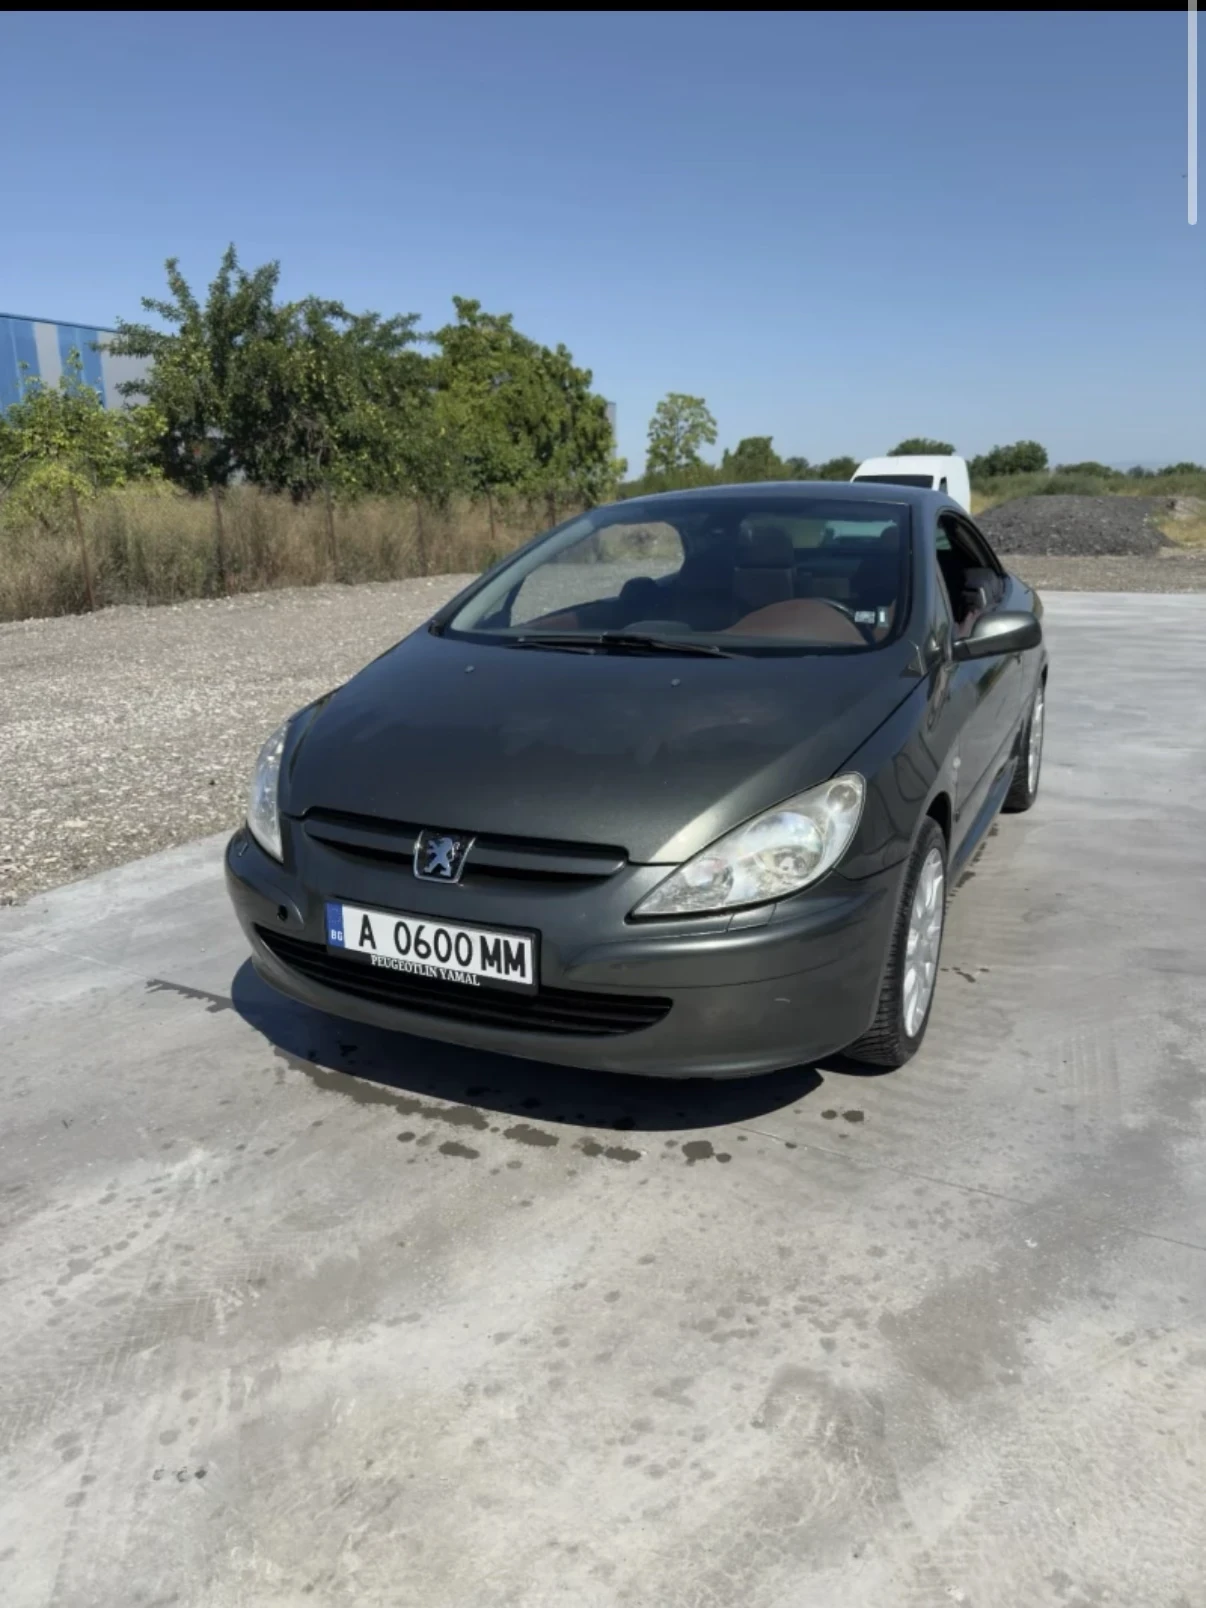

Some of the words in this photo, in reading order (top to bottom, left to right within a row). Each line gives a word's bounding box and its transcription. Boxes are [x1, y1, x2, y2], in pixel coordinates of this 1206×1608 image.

[331, 930, 343, 941] BG
[358, 914, 377, 950] A
[394, 921, 473, 967] 0600
[480, 935, 526, 978] MM
